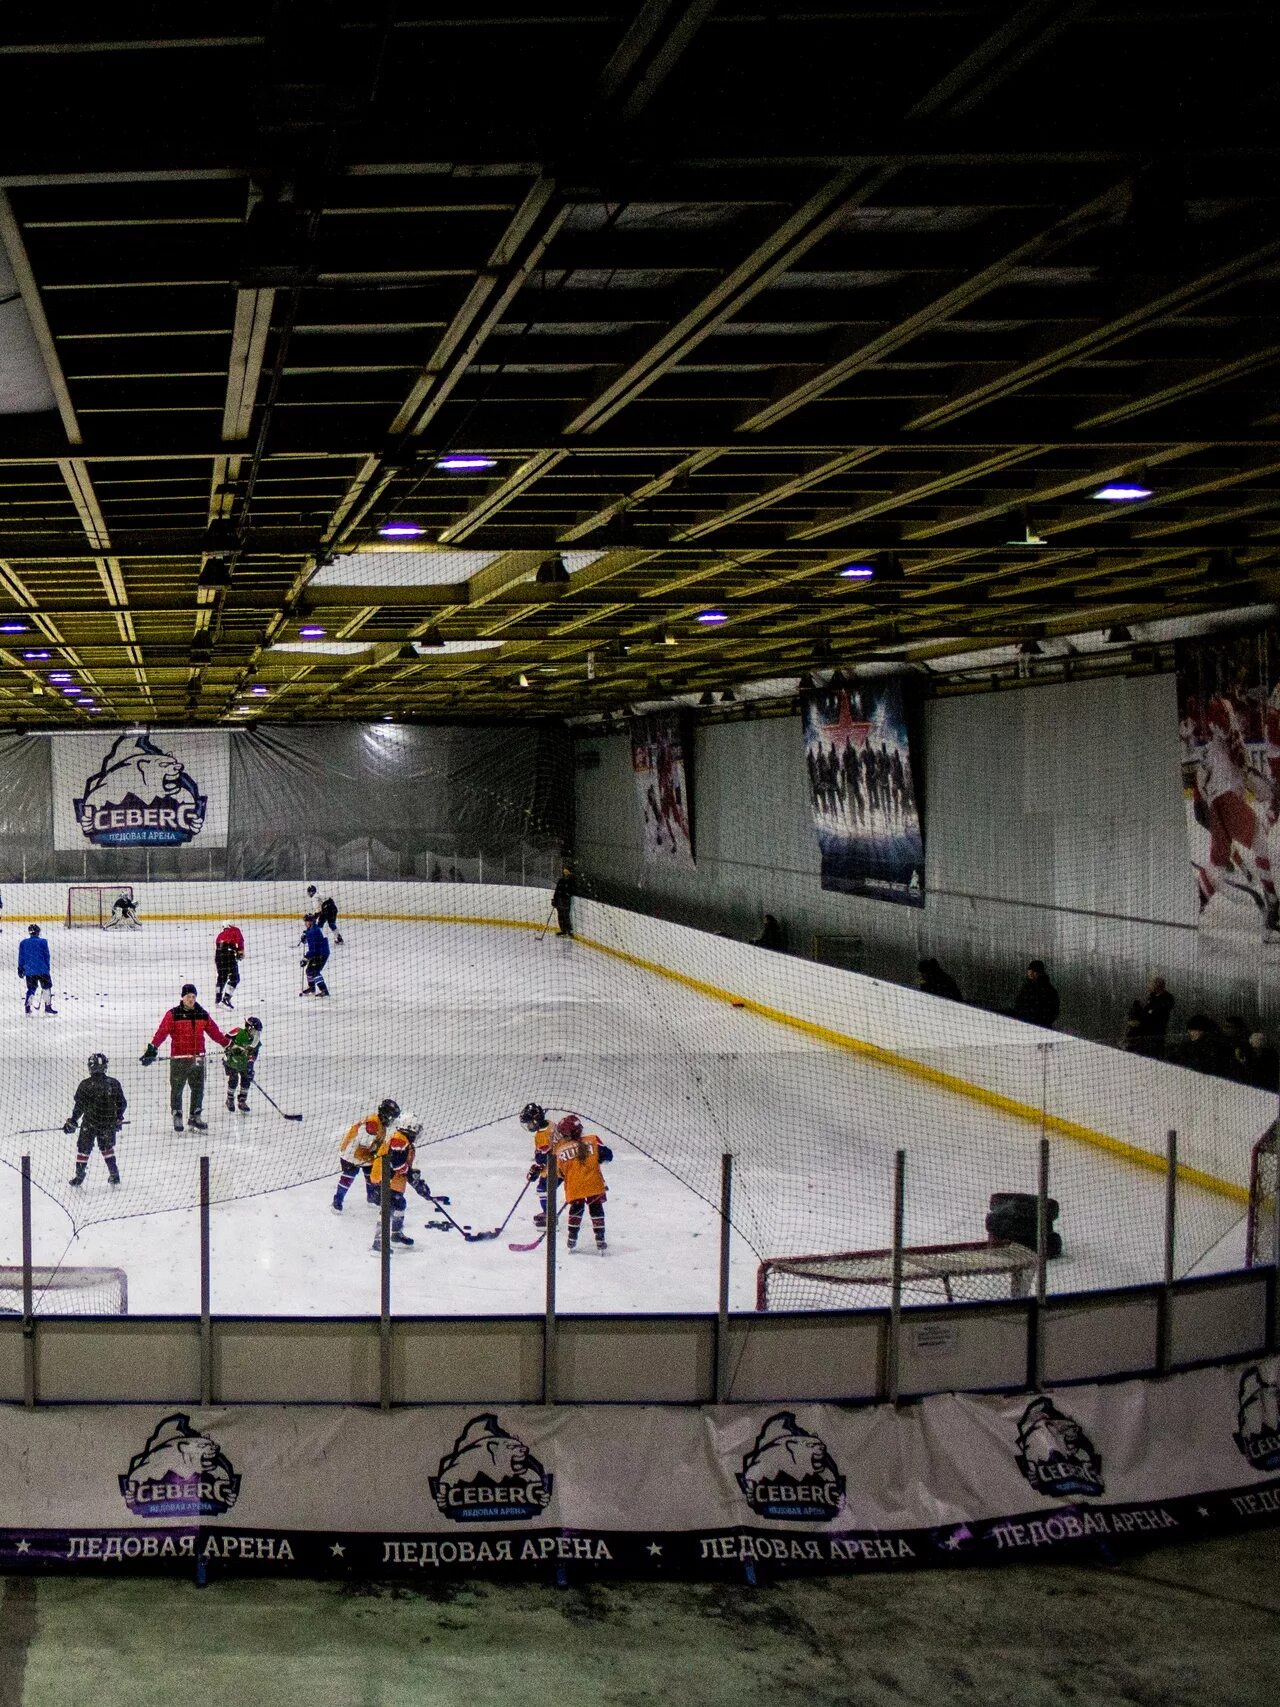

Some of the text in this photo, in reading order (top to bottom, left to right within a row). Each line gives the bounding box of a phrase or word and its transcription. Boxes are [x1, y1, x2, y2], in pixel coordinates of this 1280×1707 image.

[86, 804, 197, 830] ICEBERG
[148, 832, 176, 841] АРЕНА
[129, 1480, 234, 1503] ICEBERG
[440, 1483, 546, 1506] ICEBERG
[747, 1483, 841, 1506] ICEBERG
[500, 1507, 527, 1516] АРЕНА
[991, 1508, 1181, 1549] ЛЕДОВАЯ АРЕНА
[67, 1536, 295, 1562] ЛЕДОВАЯ АРЕНА
[382, 1538, 614, 1567] ЛЕДОВАЯ АРЕНА
[700, 1536, 916, 1562] ЛЕДОВАЯ АРЕНА
